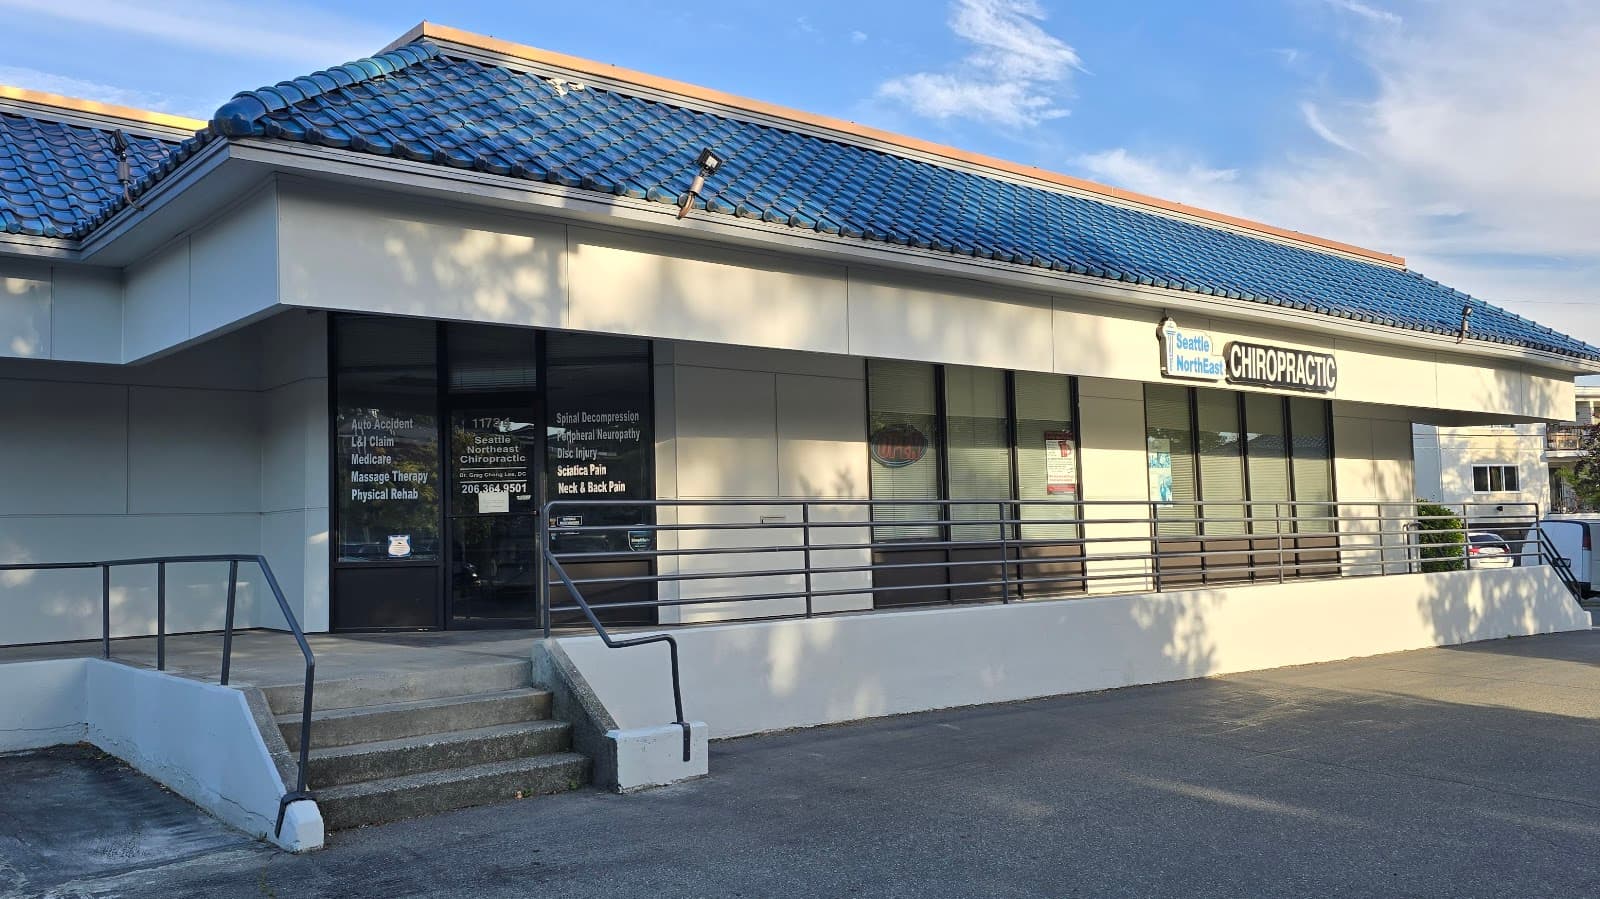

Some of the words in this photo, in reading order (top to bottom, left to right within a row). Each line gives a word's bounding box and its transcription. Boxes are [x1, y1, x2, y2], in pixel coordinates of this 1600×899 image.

[1176, 332, 1210, 353] Seattle
[1176, 355, 1224, 376] NorthEast
[1230, 344, 1336, 389] CHIROPRACTIC
[351, 419, 372, 430] Auto
[374, 418, 413, 430] Accident
[556, 412, 580, 426] Spinal
[582, 410, 640, 424] Decompression
[369, 435, 395, 447] Claim
[474, 435, 511, 444] Seattle
[557, 428, 595, 443] Peripheral
[597, 427, 641, 443] Neuropathy
[467, 445, 520, 454] Northeast
[557, 447, 574, 459] Disc
[575, 446, 598, 461] Injury
[351, 453, 392, 465] Medicare
[460, 454, 526, 465] Chiropractic
[351, 470, 390, 484] Massage
[392, 470, 428, 484] Therapy
[557, 464, 589, 477] Sciatica
[589, 463, 607, 476] Pain
[461, 483, 527, 494] 206.364.9501
[558, 481, 578, 494] Neck
[579, 481, 586, 494] &
[587, 480, 608, 493] Back
[608, 480, 626, 493] Pain
[351, 487, 389, 503] Physical
[391, 487, 419, 500] Rehab
